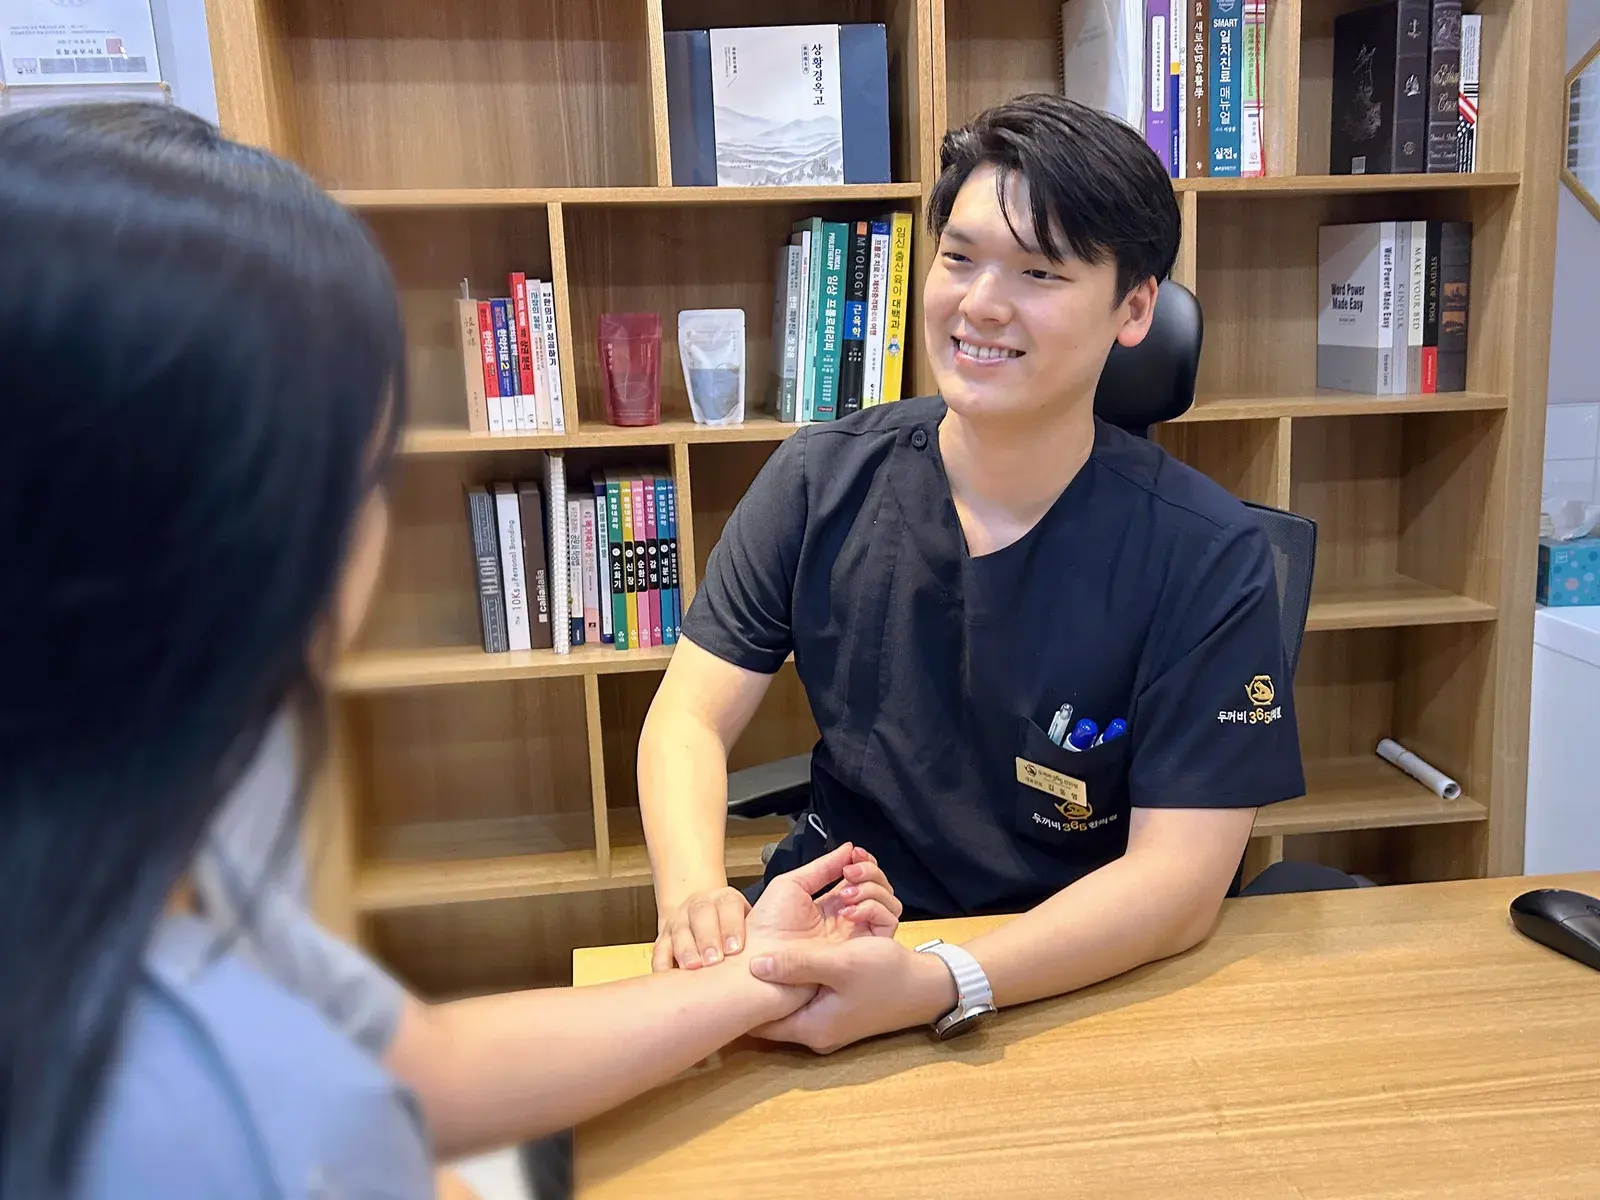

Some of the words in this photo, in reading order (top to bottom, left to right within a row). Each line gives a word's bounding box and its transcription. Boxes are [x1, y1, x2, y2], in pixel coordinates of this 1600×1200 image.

[1213, 18, 1238, 28] SMART
[1219, 29, 1232, 83] 일차진료
[811, 43, 825, 106] 상황경옥고
[1219, 86, 1231, 125] 매뉴얼
[827, 232, 836, 271] PROLOTHERAPY
[895, 227, 906, 249] 임신
[854, 237, 866, 298] MYOLOGY
[894, 250, 905, 273] 출산
[1384, 247, 1392, 265] Word
[1413, 247, 1422, 276] MAKE
[1383, 268, 1392, 288] Power
[1429, 256, 1438, 285] STUDY
[826, 275, 839, 295] 임상
[892, 274, 904, 296] 육아
[1331, 283, 1346, 296] Word
[1346, 284, 1366, 297] Power
[1413, 280, 1421, 309] YOUR
[1429, 286, 1437, 298] OF
[891, 298, 902, 330] 대백과
[1332, 297, 1348, 310] Made
[1349, 298, 1364, 313] Easy
[1383, 290, 1392, 311] Made
[1396, 283, 1405, 329] KINFOLK
[1428, 302, 1437, 324] POSE
[823, 298, 837, 351] 프롤로테라피
[852, 303, 863, 338] 근육학
[1382, 312, 1391, 328] Easy
[1412, 312, 1421, 330] BED
[547, 332, 557, 366] 성공하기
[507, 519, 516, 550] Branding
[480, 557, 498, 595] HOTH
[509, 551, 518, 581] Personal
[613, 561, 622, 589] 소화기
[626, 562, 635, 586] 신장
[637, 559, 646, 587] 순환기
[649, 560, 657, 582] 감염
[661, 558, 670, 585] 내분비
[511, 588, 522, 611] 10Ks
[536, 569, 547, 613] caliaitalia
